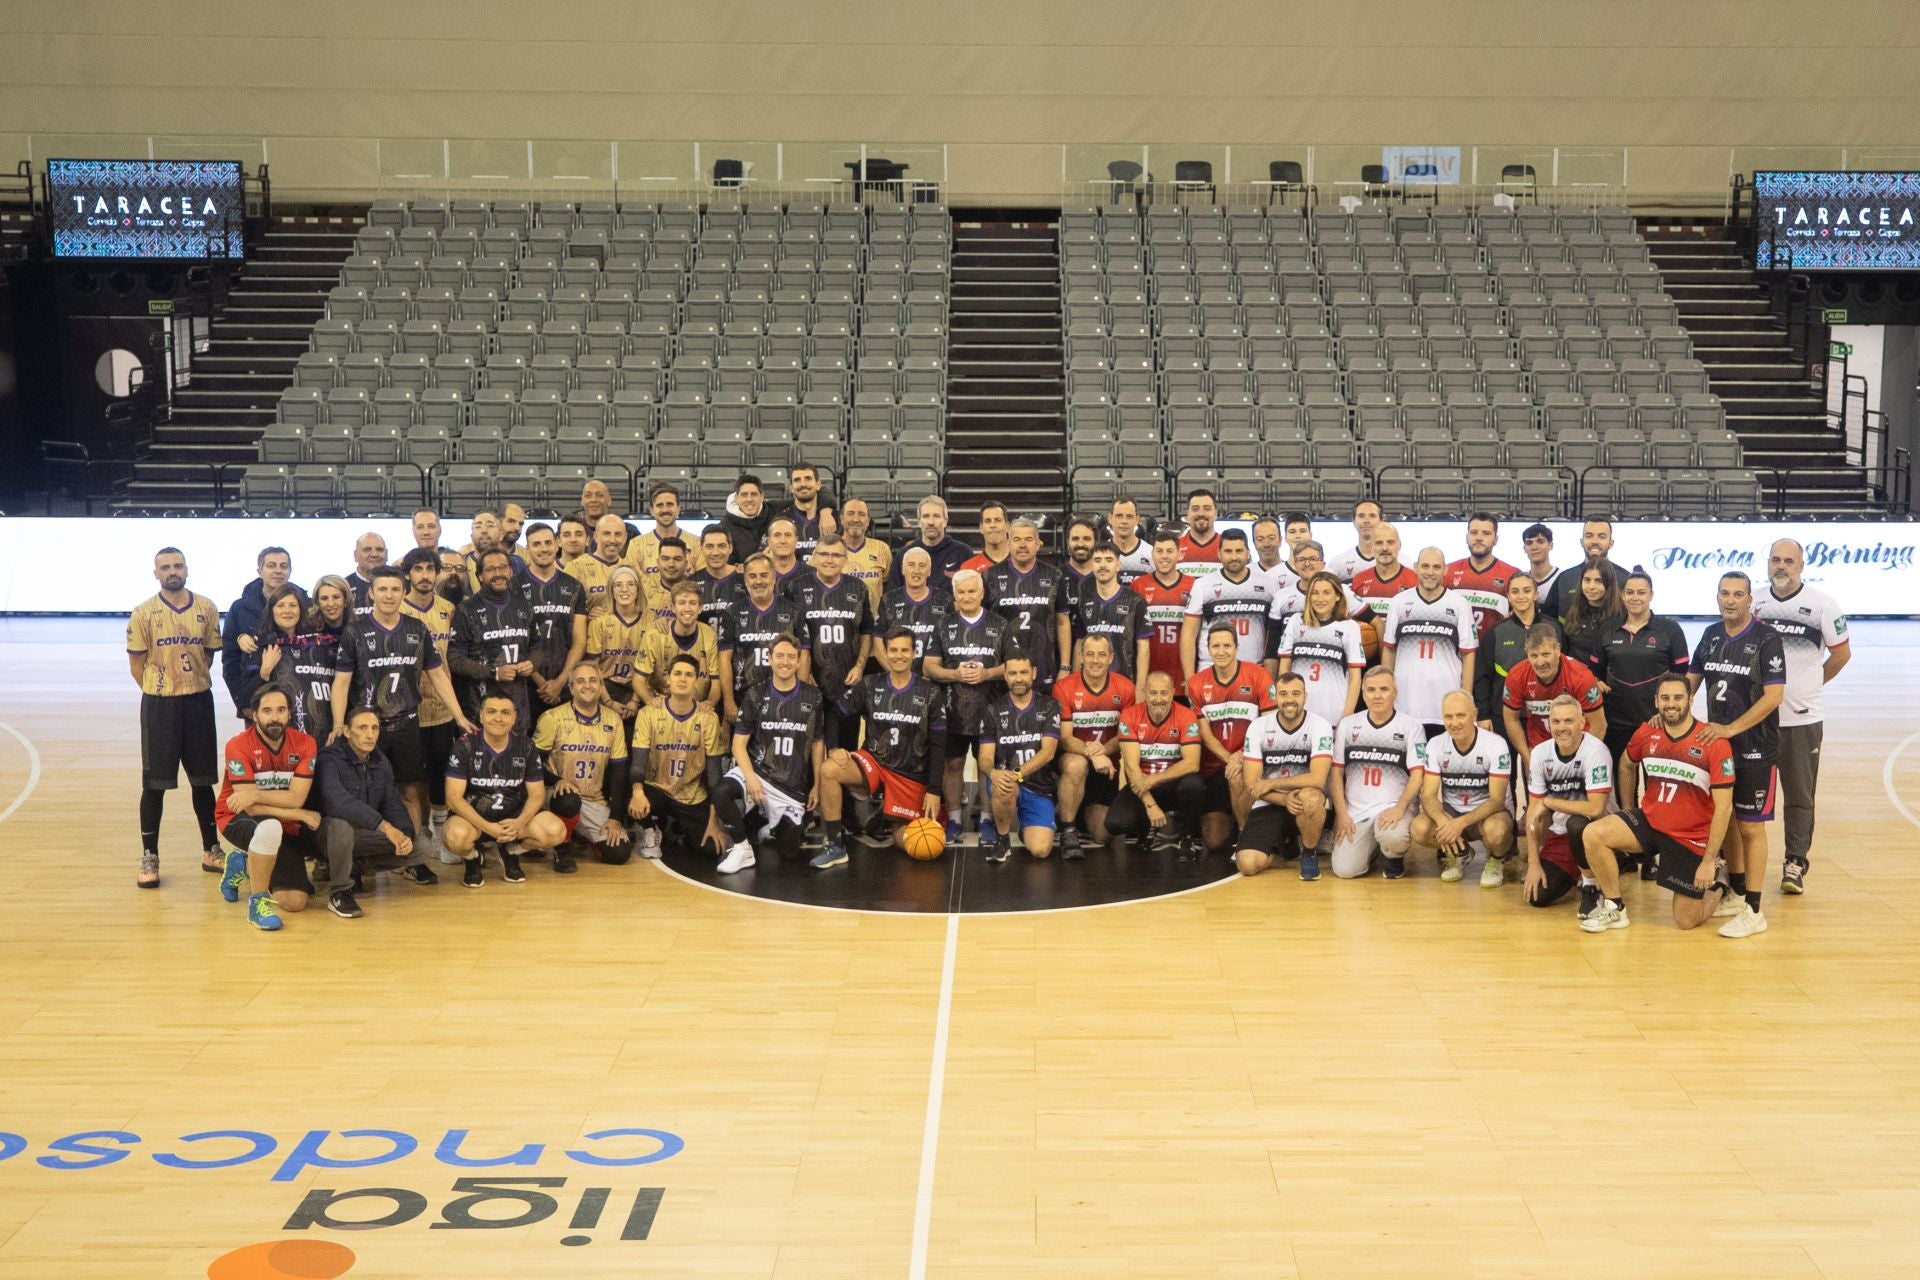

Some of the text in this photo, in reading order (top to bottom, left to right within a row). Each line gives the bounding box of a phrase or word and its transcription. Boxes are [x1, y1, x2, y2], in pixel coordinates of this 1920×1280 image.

[73, 196, 217, 215] TARACEA
[1775, 207, 1914, 225] TARACEA
[533, 601, 570, 614] OVIRAN
[999, 594, 1049, 606] COVIRAN
[1213, 601, 1265, 613] COVIRAN
[806, 607, 856, 619] COVIRAN
[1019, 612, 1031, 630] 2
[483, 625, 528, 640] COVIRAN
[545, 620, 553, 639] 7
[820, 625, 844, 644] 00
[1158, 625, 1178, 644] 15
[1401, 622, 1453, 636] COVIRAN
[502, 644, 518, 663] 17
[1294, 644, 1343, 659] COVIRAN
[1419, 640, 1434, 659] 11
[181, 653, 193, 673] 3
[1704, 660, 1752, 676] COVIRAN
[1309, 663, 1320, 682] 3
[389, 673, 400, 693] 7
[1716, 680, 1728, 702] 2
[873, 709, 921, 724] COVIRAN
[890, 727, 900, 746] 3
[999, 731, 1042, 744] COVIRA
[773, 736, 794, 756] 10
[1349, 749, 1400, 763] COVIRAN
[1363, 768, 1383, 787] 10
[1646, 763, 1697, 781] COVIRAN
[1658, 781, 1678, 803] 17
[491, 793, 504, 810] 2
[282, 1177, 667, 1247] liga
